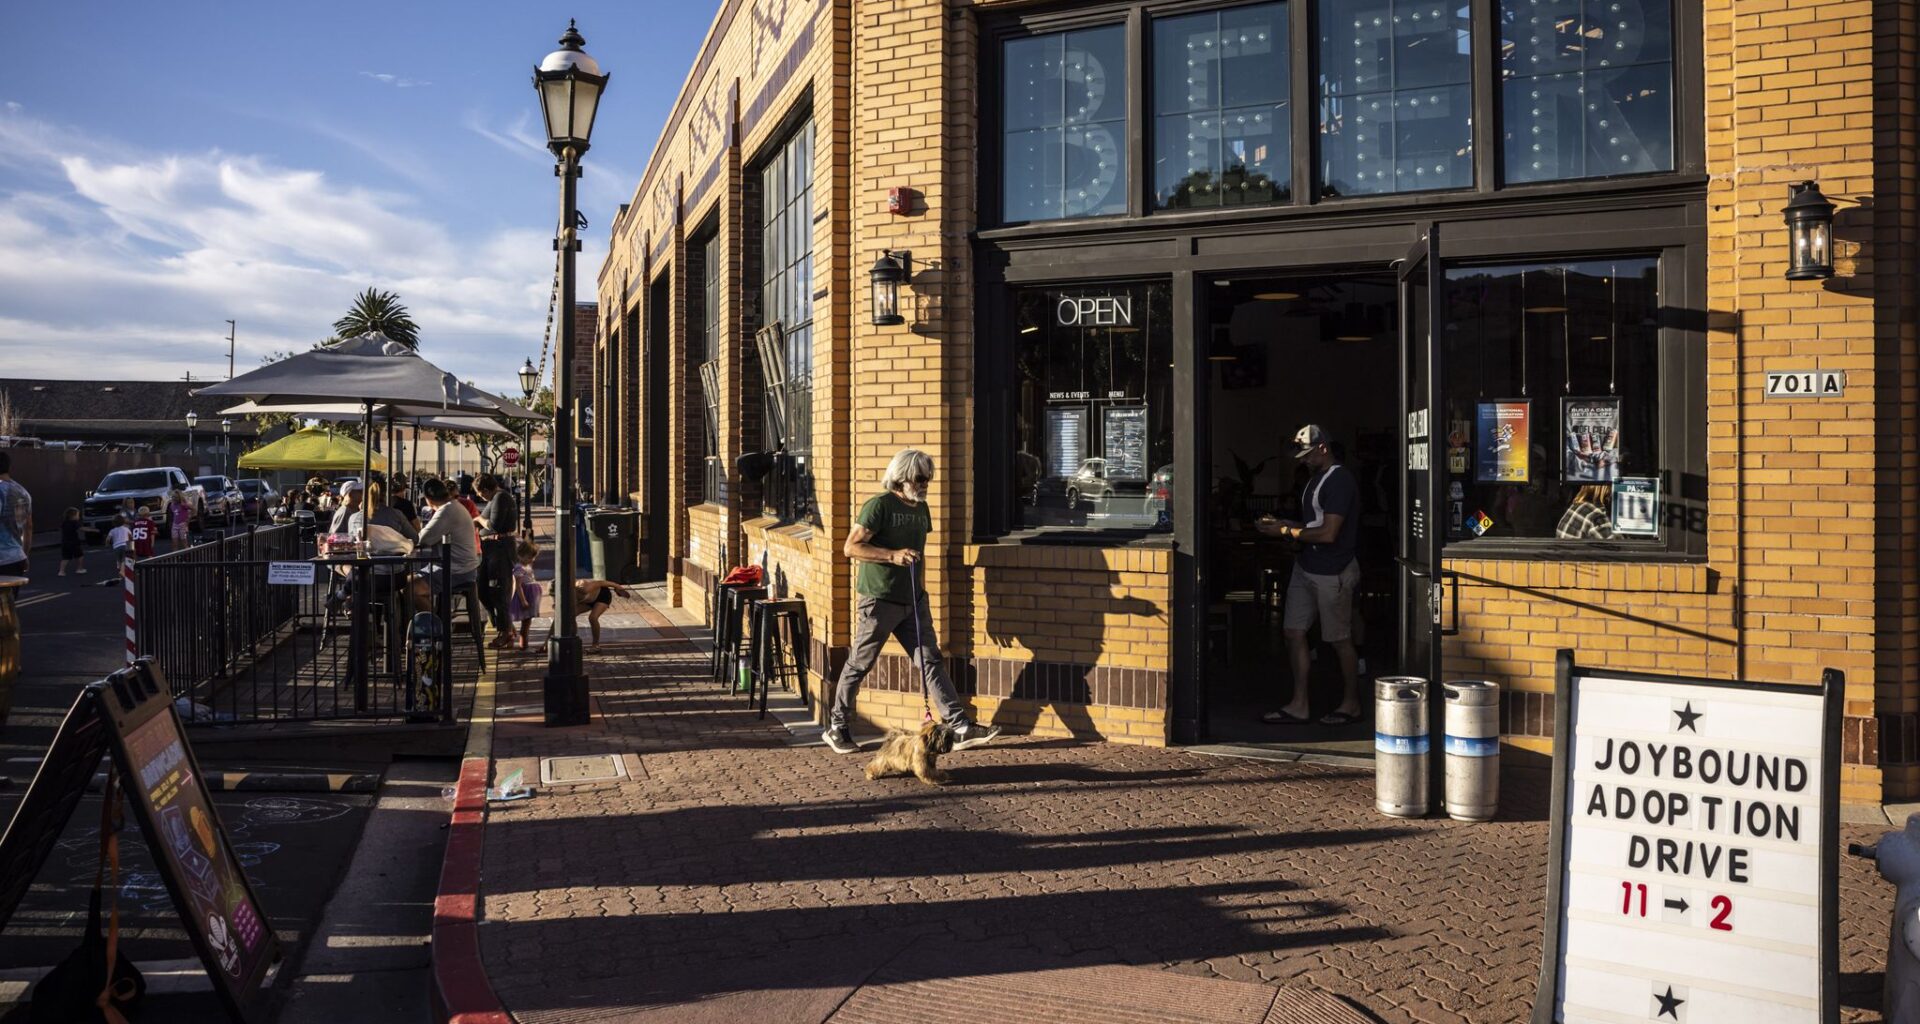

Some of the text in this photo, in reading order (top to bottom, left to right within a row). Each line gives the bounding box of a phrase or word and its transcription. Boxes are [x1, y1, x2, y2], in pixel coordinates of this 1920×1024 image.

[1057, 297, 1131, 325] OPEN
[1769, 374, 1839, 393] 701 A
[1065, 391, 1070, 399] &
[1070, 391, 1090, 399] EVENTS
[1108, 390, 1125, 398] MENU
[504, 452, 519, 460] STOP
[1626, 485, 1645, 493] PASS
[132, 527, 149, 541] 85
[1594, 738, 1808, 793] JOYBOUND
[1587, 784, 1799, 841] ADOPTION
[1628, 835, 1749, 883] DRIVE
[1621, 881, 1733, 931] 11 2
